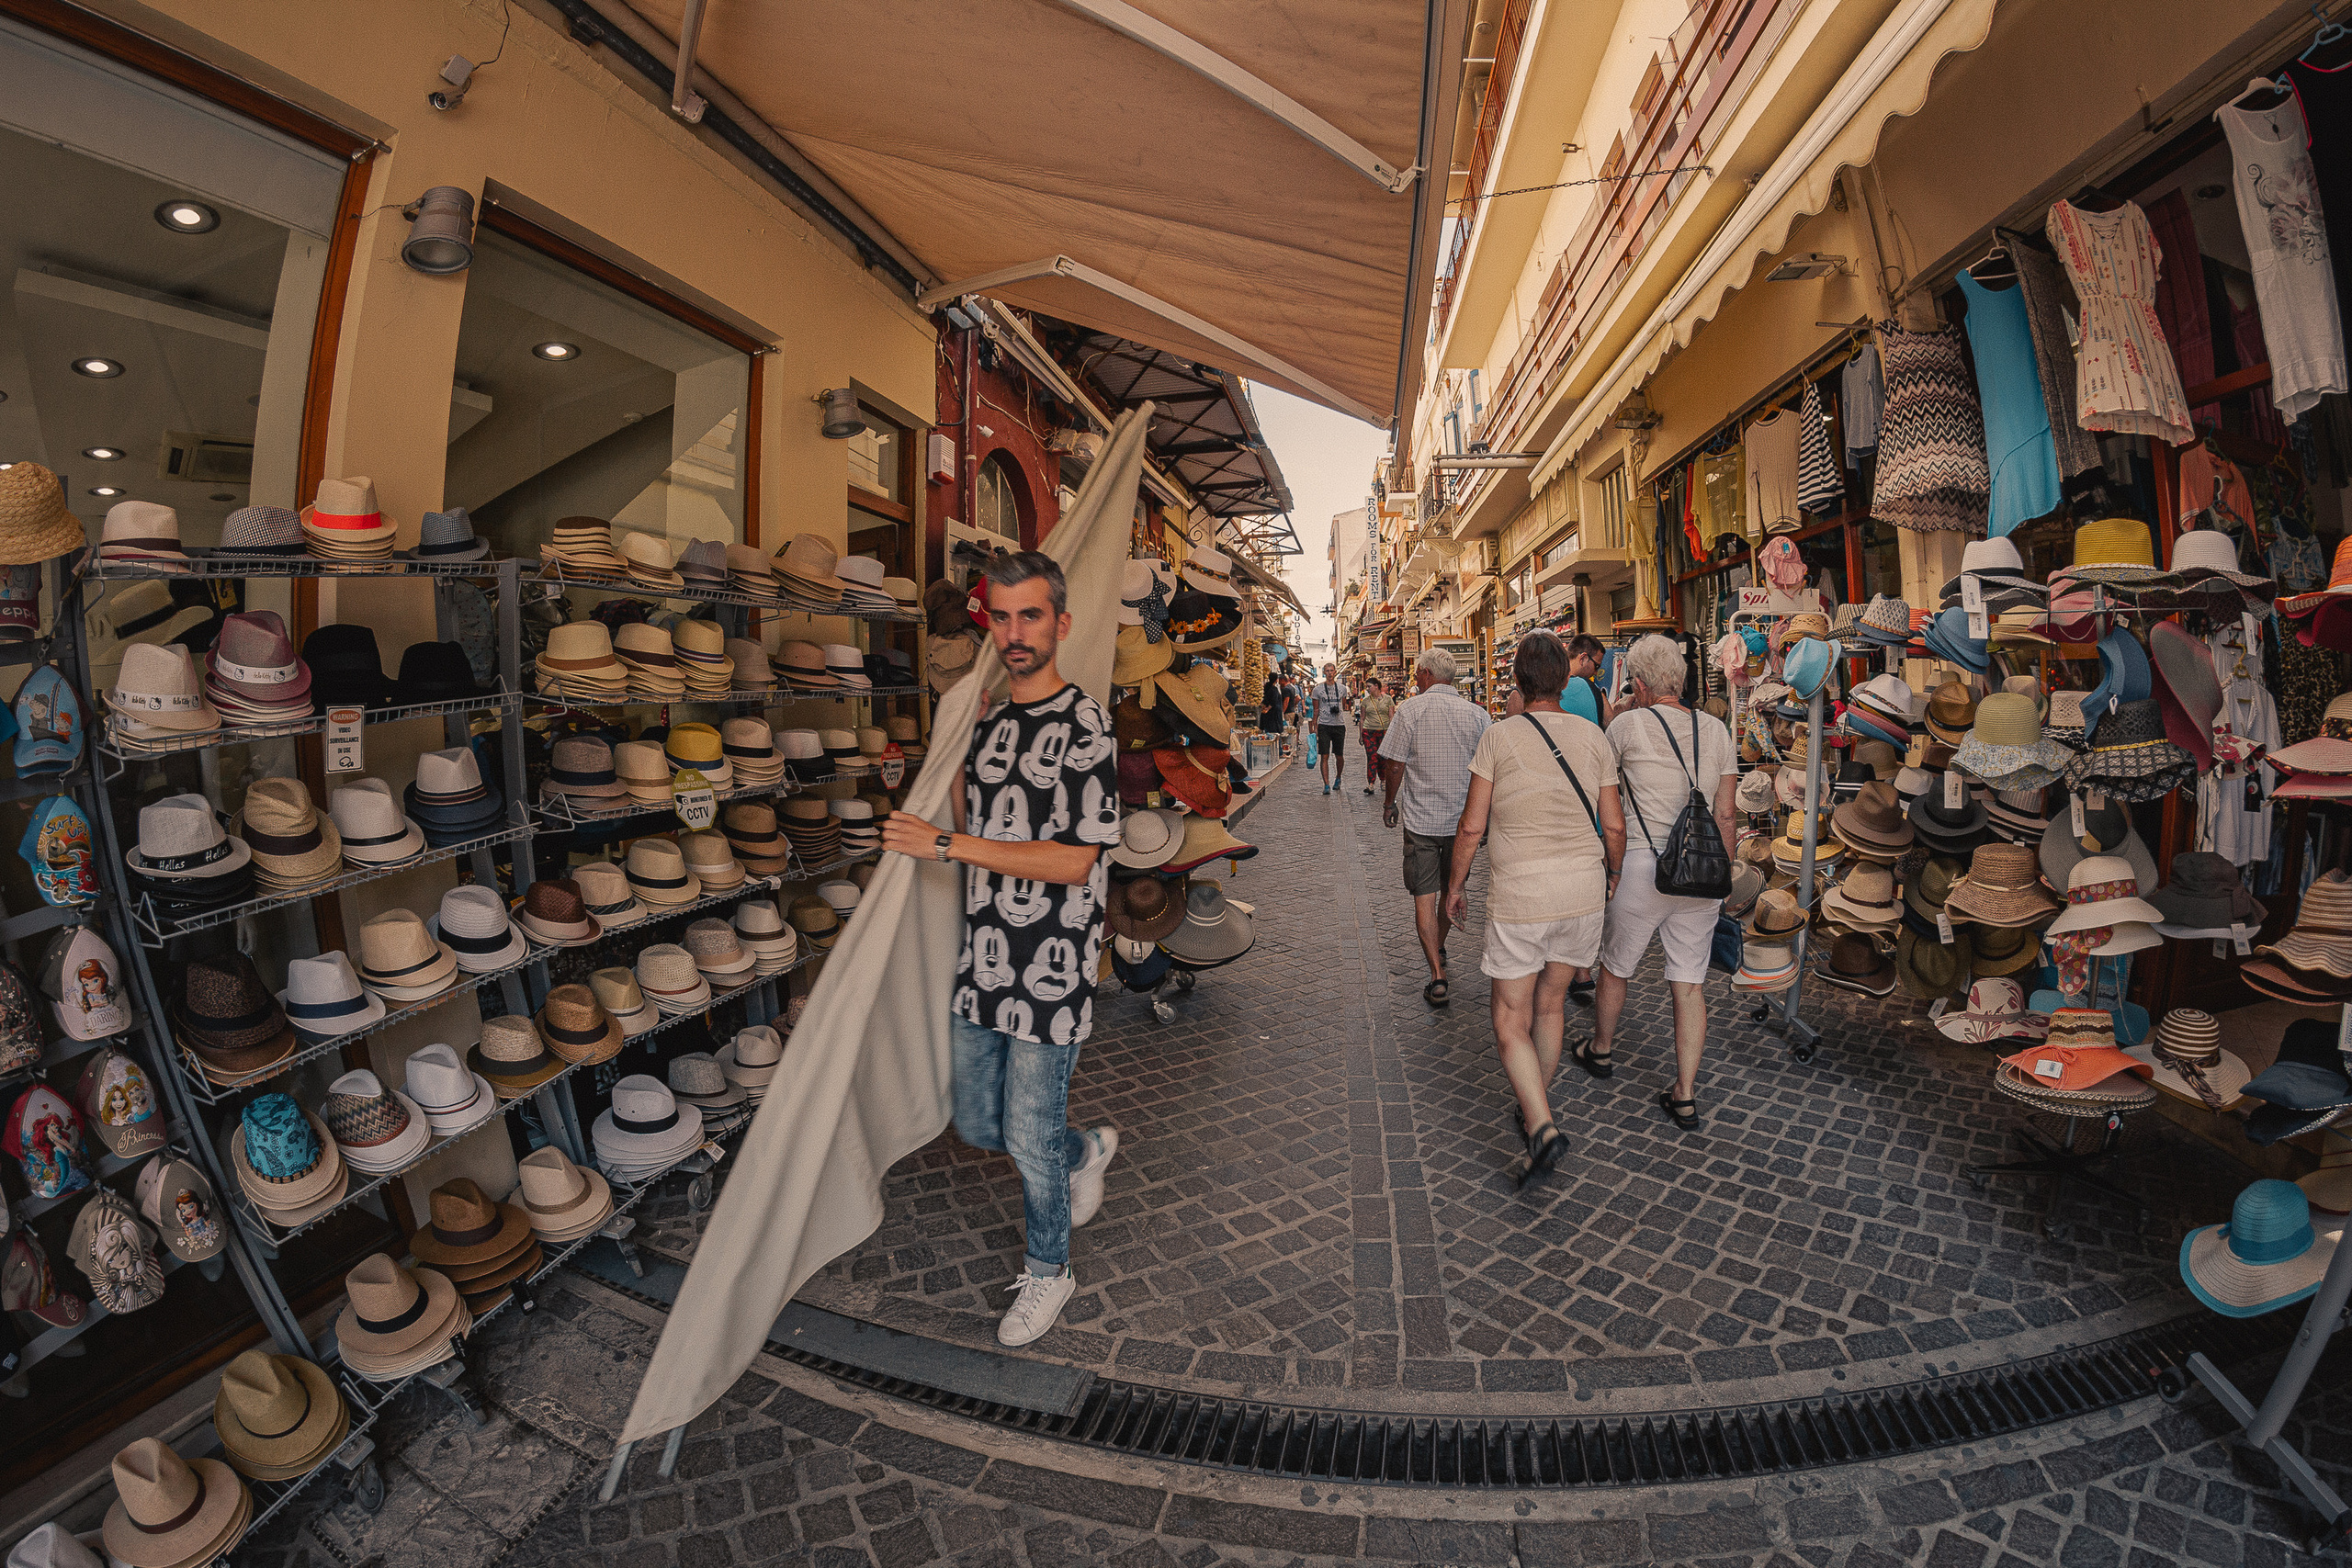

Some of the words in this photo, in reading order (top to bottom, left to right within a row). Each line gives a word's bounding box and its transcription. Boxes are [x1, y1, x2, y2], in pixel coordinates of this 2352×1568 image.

[1367, 498, 1378, 538] ROOMS
[1370, 566, 1379, 600] RENT
[0, 607, 37, 621] eppa
[887, 772, 899, 781] CCTV
[675, 781, 708, 789] TRESPASSING
[687, 806, 708, 819] CCTV
[159, 858, 186, 871] Hellas
[205, 846, 228, 863] Hellas
